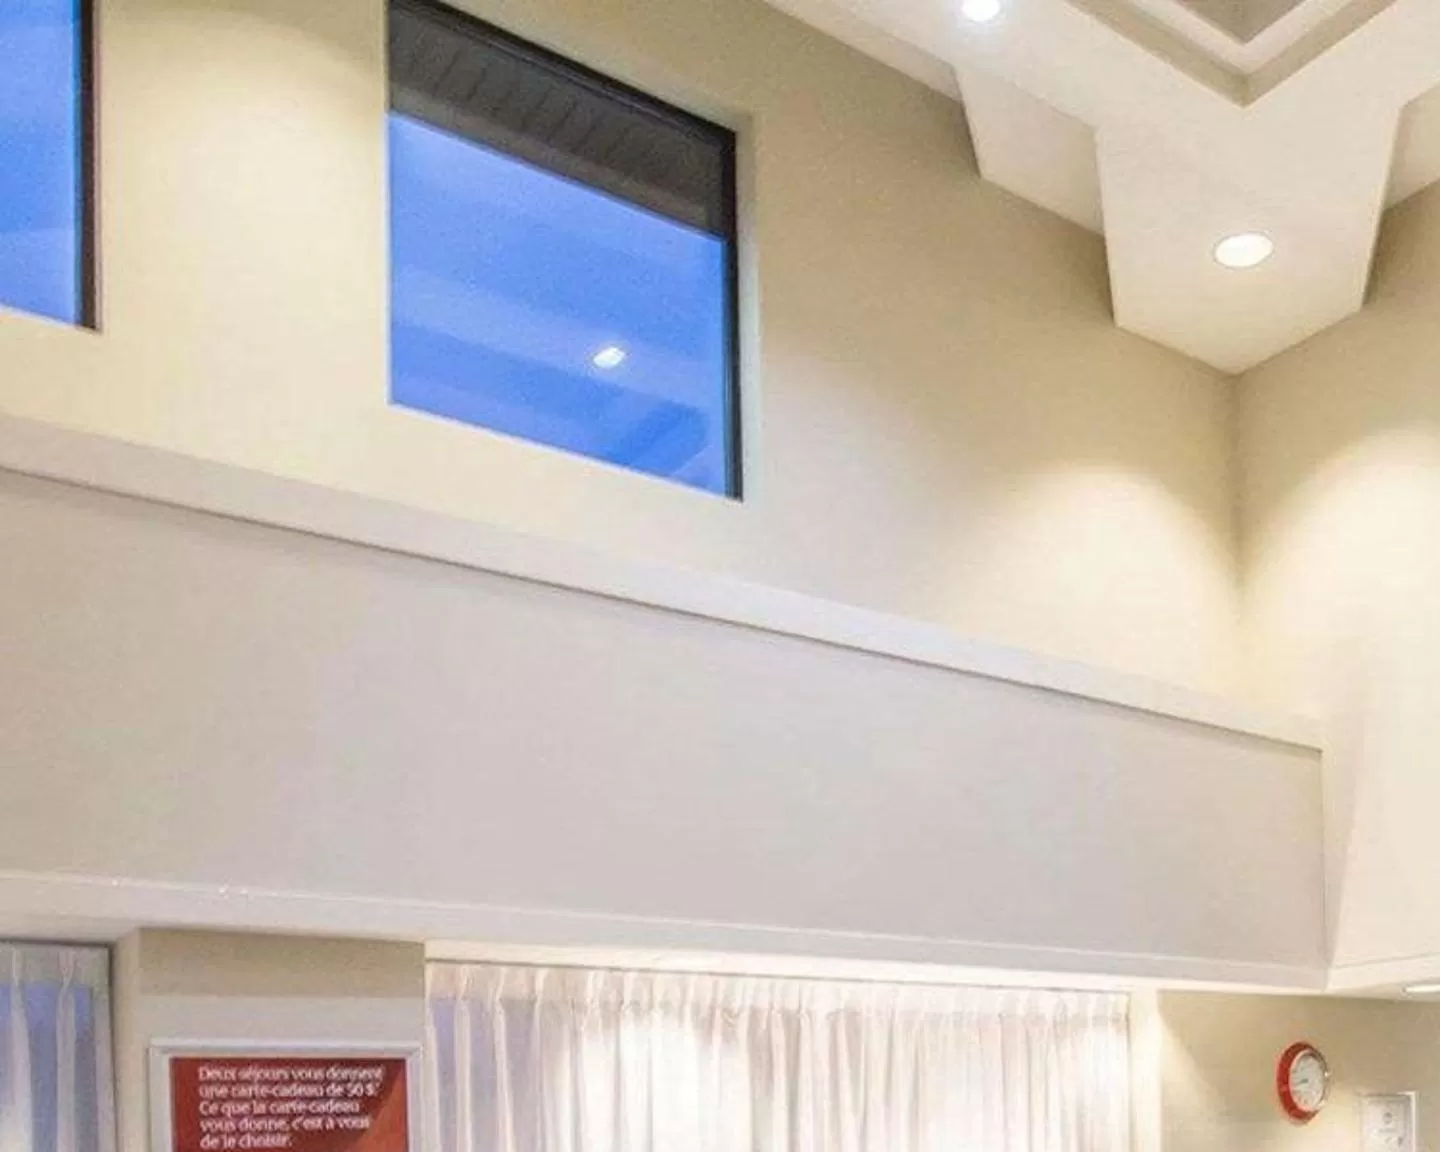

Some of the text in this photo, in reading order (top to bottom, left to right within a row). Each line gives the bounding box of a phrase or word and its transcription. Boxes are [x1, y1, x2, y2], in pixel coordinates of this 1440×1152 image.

[199, 1067, 383, 1083] Deux séjours vous donnent
[199, 1086, 228, 1098] une
[326, 1083, 344, 1096] de
[199, 1101, 218, 1115] Ce
[220, 1102, 251, 1118] que
[252, 1100, 267, 1114] la
[199, 1120, 236, 1132] vous
[338, 1117, 370, 1128] vous
[200, 1135, 220, 1148] de
[222, 1135, 237, 1148] le
